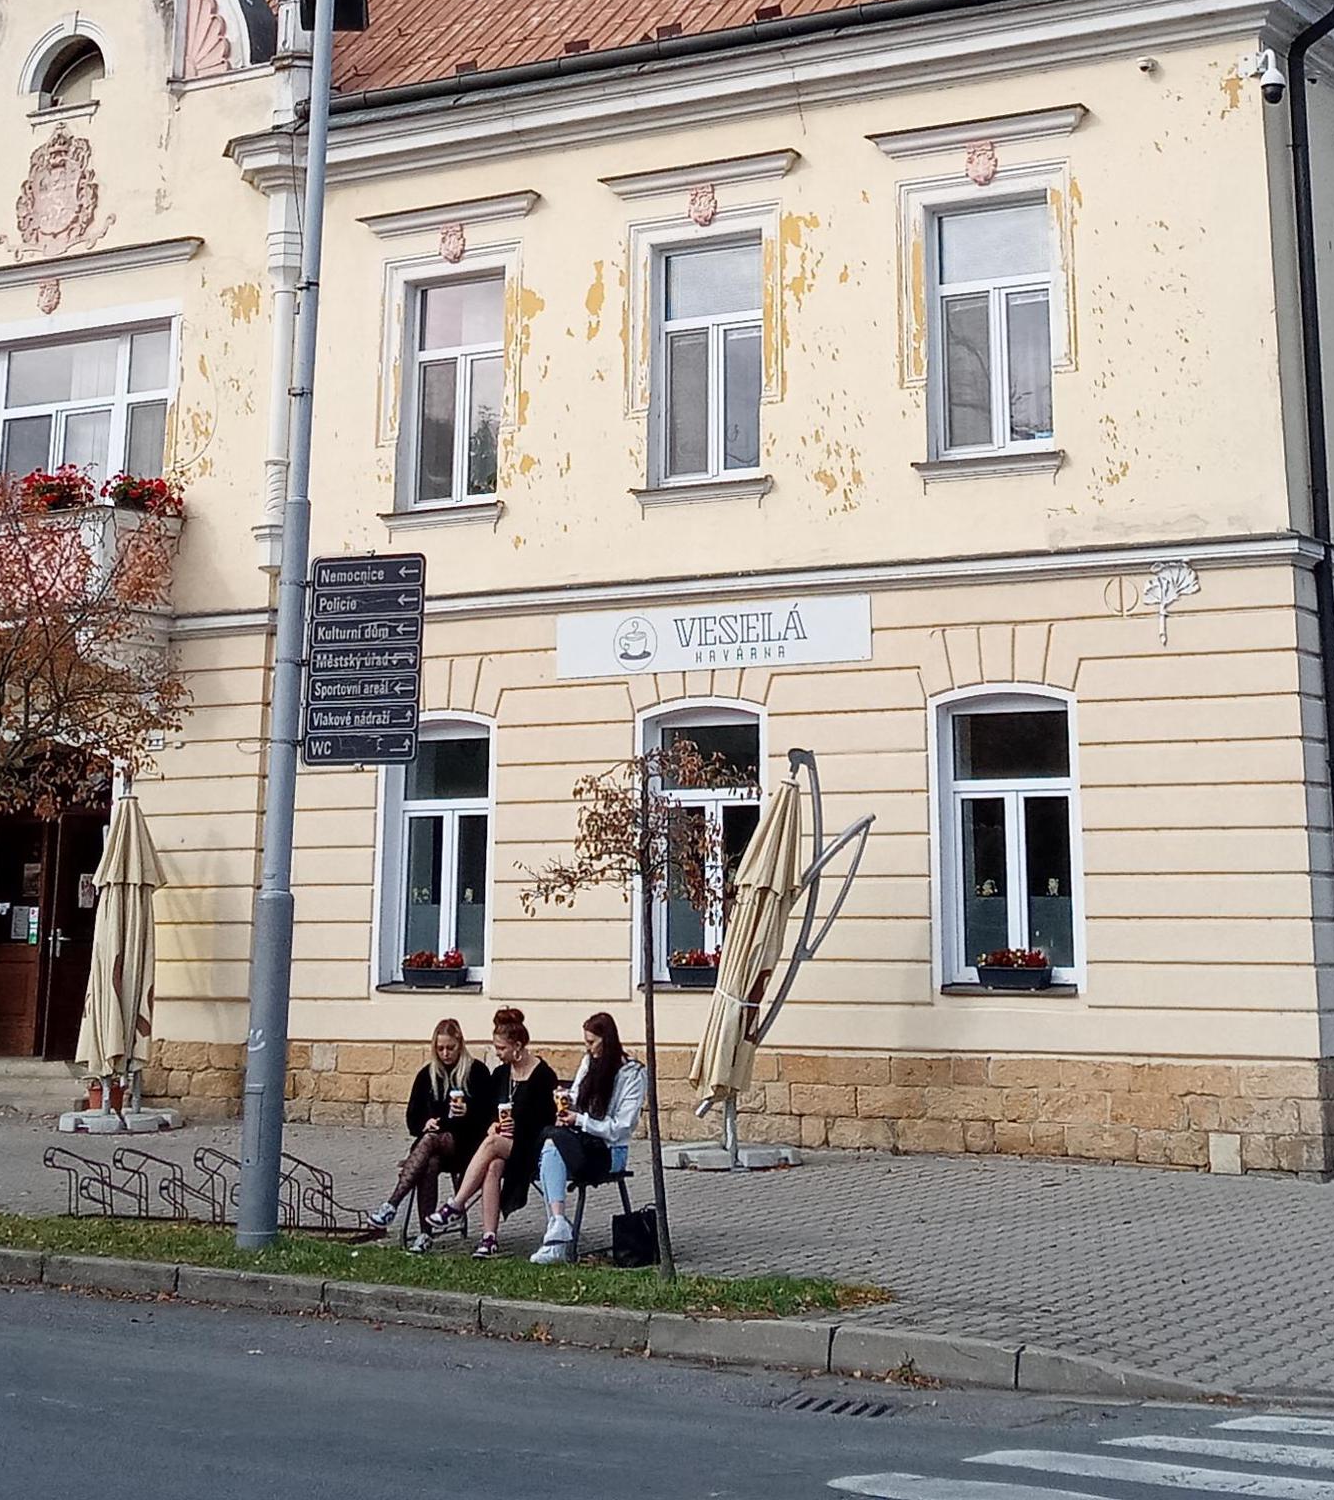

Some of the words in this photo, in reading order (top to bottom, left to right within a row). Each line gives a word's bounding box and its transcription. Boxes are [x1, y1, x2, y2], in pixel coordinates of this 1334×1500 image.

[320, 565, 385, 583] Nemocnice
[319, 596, 357, 611] Policie
[317, 624, 361, 640] Kulturní
[673, 603, 808, 648] VESELÁ
[695, 645, 786, 663] KAVÁRNA
[314, 680, 361, 699] Sportovní
[312, 710, 351, 726] Vlakové
[353, 709, 391, 725] nádraží
[310, 740, 332, 756] WC
